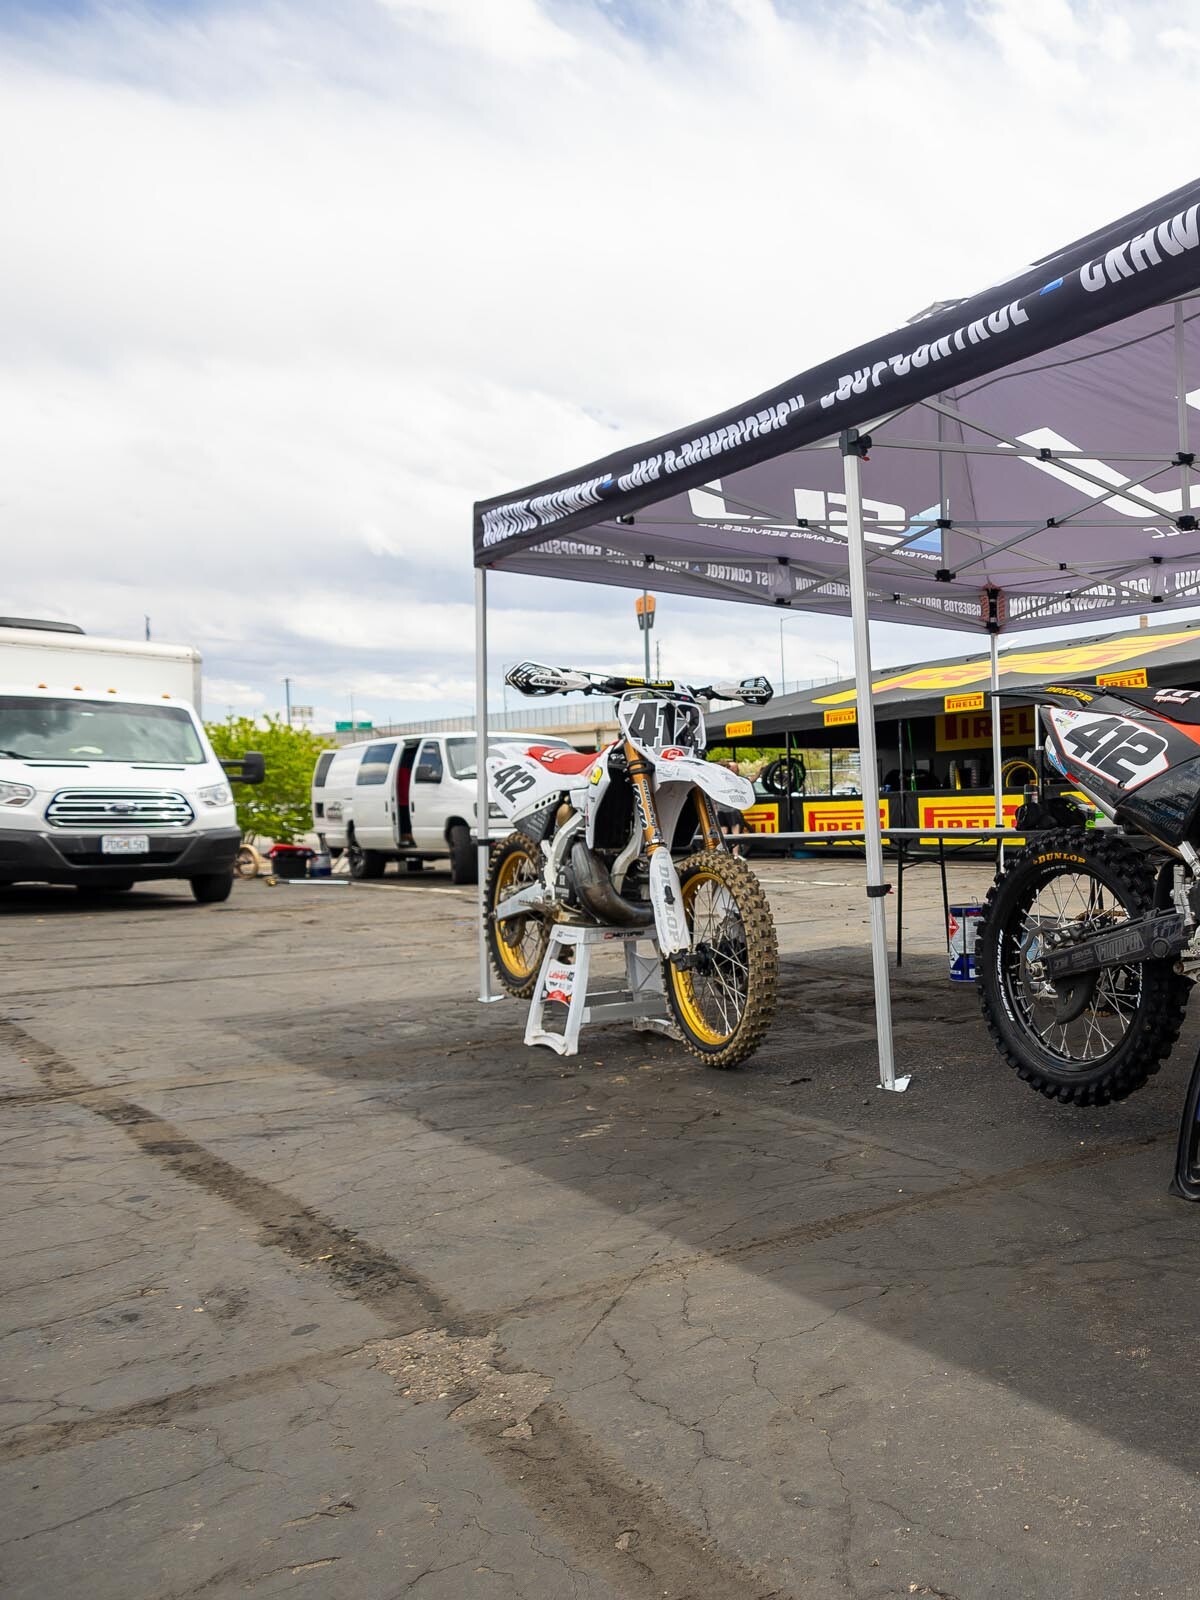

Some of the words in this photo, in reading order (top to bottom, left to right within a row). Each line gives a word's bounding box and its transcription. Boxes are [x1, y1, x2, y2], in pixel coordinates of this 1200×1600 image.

[946, 695, 983, 710] PIRELLI
[1064, 716, 1163, 784] 412
[491, 764, 537, 802] 412
[1038, 852, 1086, 865] DUNLOP
